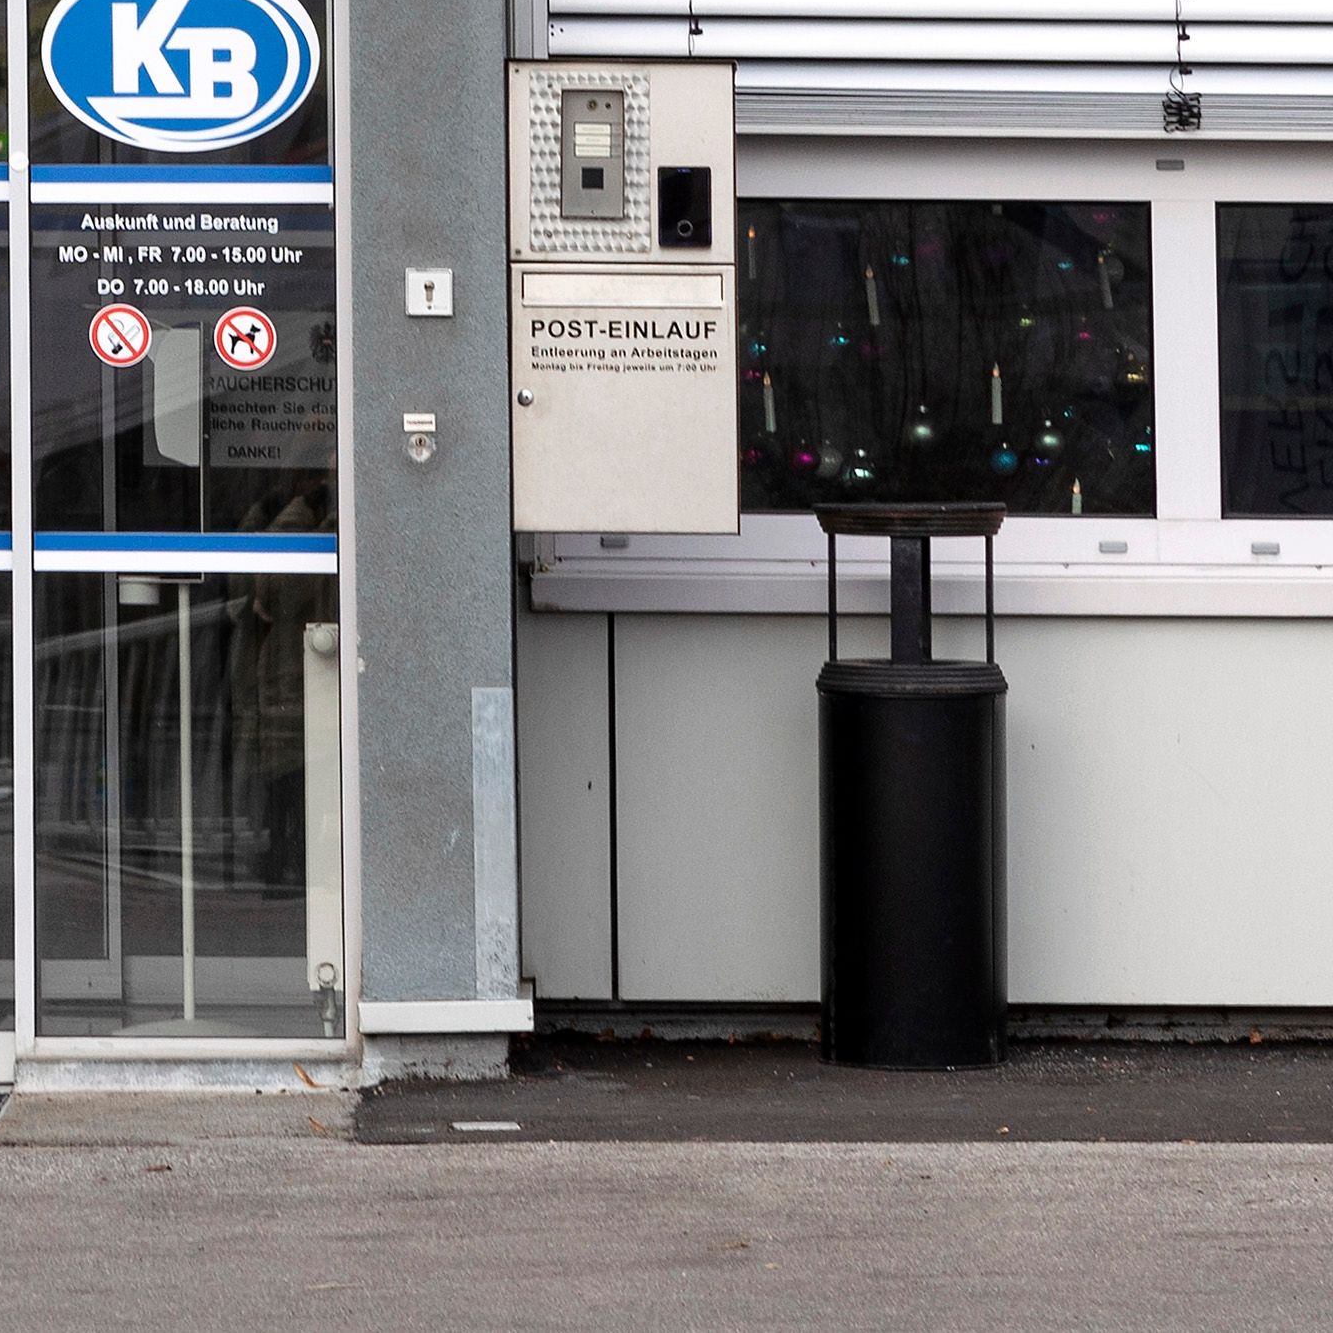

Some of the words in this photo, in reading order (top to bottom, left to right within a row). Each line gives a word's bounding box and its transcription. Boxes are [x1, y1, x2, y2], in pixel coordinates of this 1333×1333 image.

[81, 213, 159, 231] Auskunft
[162, 213, 196, 231] und
[199, 213, 279, 235] Beratung
[58, 245, 88, 263] MO
[137, 245, 163, 263] FR
[171, 245, 207, 263] 7.00
[221, 246, 267, 264] 15.00
[271, 246, 303, 264] Uhr
[97, 278, 125, 296] DO
[133, 278, 169, 296] 7.00
[184, 278, 229, 296] 18.00
[233, 278, 266, 296] Uhr
[531, 319, 717, 340] POST-EINLAUF
[531, 345, 606, 361] Entleerung
[610, 349, 627, 358] an
[630, 347, 718, 362] Arbeitstagen
[531, 361, 567, 373] Montag
[569, 362, 584, 371] bis
[586, 362, 621, 373] Freitag
[699, 364, 717, 373] Uhr
[207, 375, 335, 393] RAUCHERSCHU
[210, 401, 276, 415] beachten
[282, 401, 305, 415] Sie
[209, 417, 246, 430] liche
[251, 418, 336, 431] Rauchverbo
[227, 445, 281, 459] DANKE!
